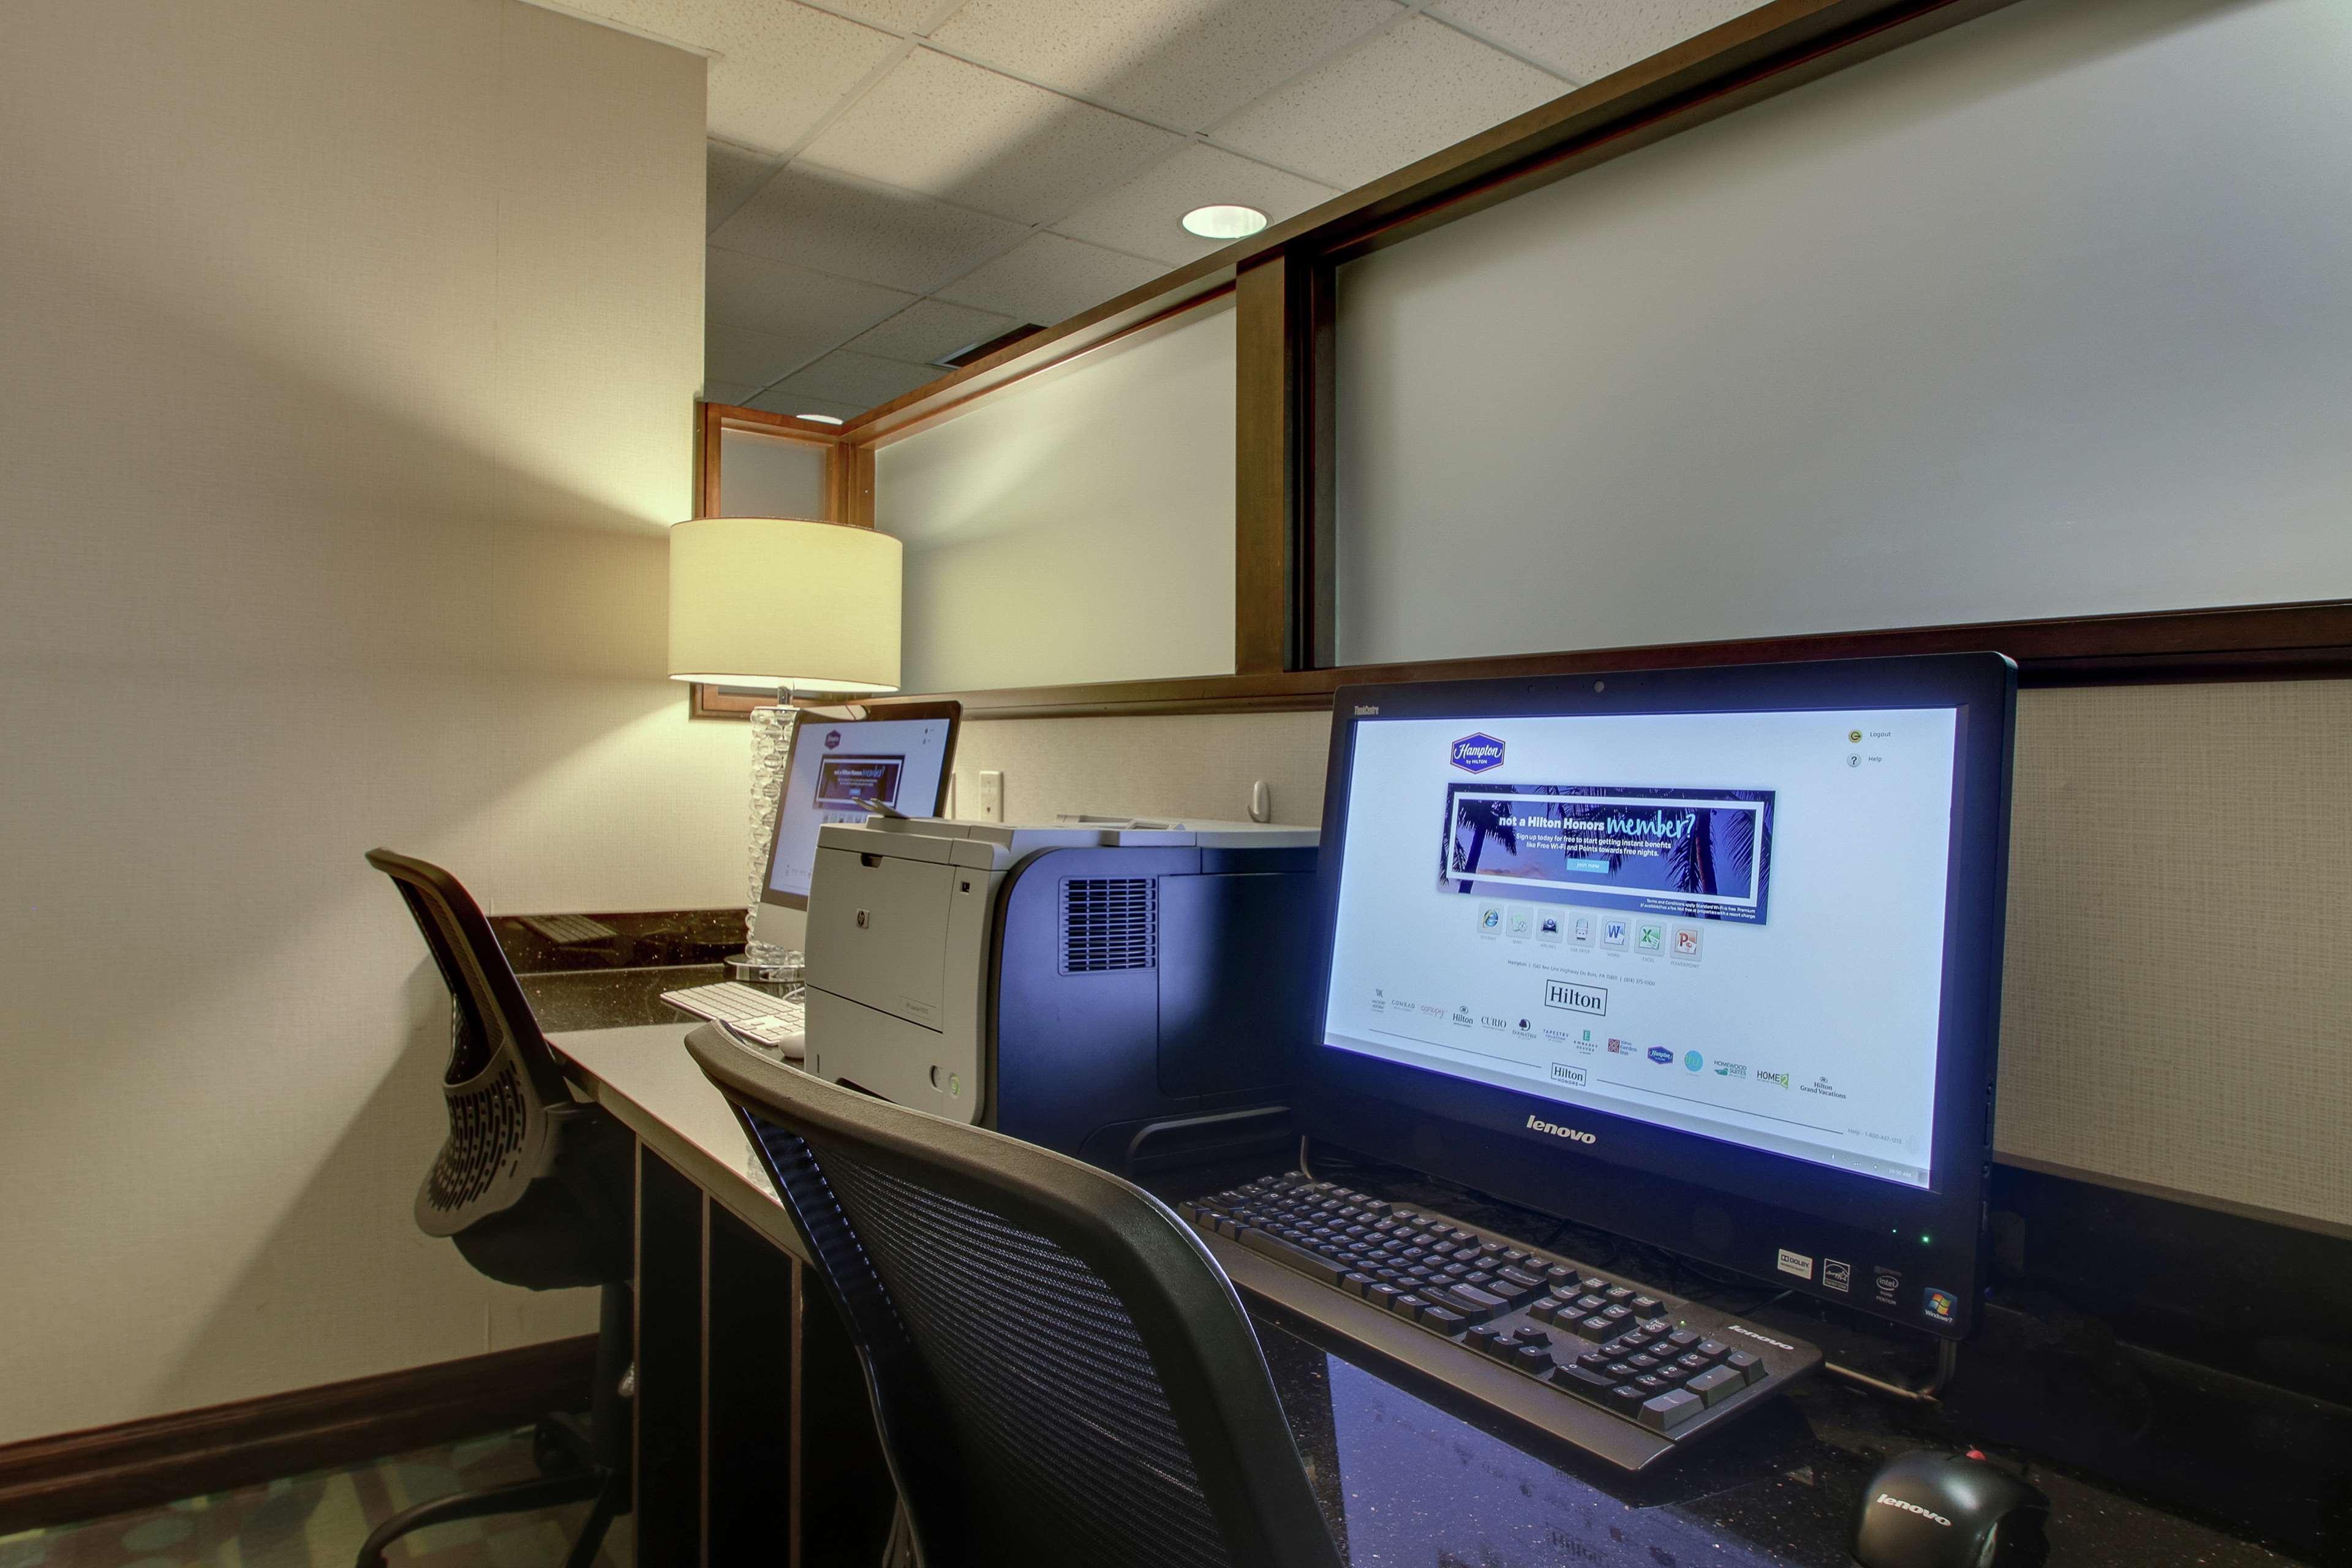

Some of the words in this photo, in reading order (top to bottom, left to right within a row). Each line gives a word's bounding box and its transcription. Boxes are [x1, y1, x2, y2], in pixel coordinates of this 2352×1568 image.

[1453, 743, 1502, 760] Hampton
[1499, 816, 1517, 827] not
[1528, 816, 1561, 829] Hilton
[1564, 818, 1605, 831] Honors
[1607, 809, 1696, 839] member?
[1599, 839, 1621, 848] getting
[1645, 840, 1672, 849] benefits
[1637, 848, 1659, 857] nights.
[1608, 925, 1621, 938] W
[1642, 929, 1653, 943] X
[1679, 932, 1689, 947] P
[1560, 967, 1579, 975] Highway
[1550, 986, 1602, 1010] Hilton
[1392, 1000, 1415, 1009] CONRAD
[1420, 1005, 1446, 1019] canopy
[1452, 1013, 1474, 1025] Hilton
[1481, 1016, 1507, 1028] CURIO
[1543, 1029, 1569, 1038] TAPESTRY
[1620, 1044, 1637, 1052] Garden
[1648, 1049, 1672, 1060] Hampton
[1714, 1060, 1747, 1071] HOMEWOOD
[1554, 1066, 1583, 1082] Hilton
[1557, 1078, 1579, 1087] HONORS
[1814, 1082, 1833, 1090] Hilton
[1800, 1085, 1817, 1094] Grand
[1818, 1088, 1847, 1099] Vacations
[1526, 1115, 1596, 1144] lenovo
[1790, 1257, 1810, 1268] DOLBY
[1879, 1276, 1895, 1287] intel
[1925, 1309, 1948, 1322] Windows
[1728, 1325, 1794, 1350] lenovo
[1877, 1493, 1952, 1527] lenovo
